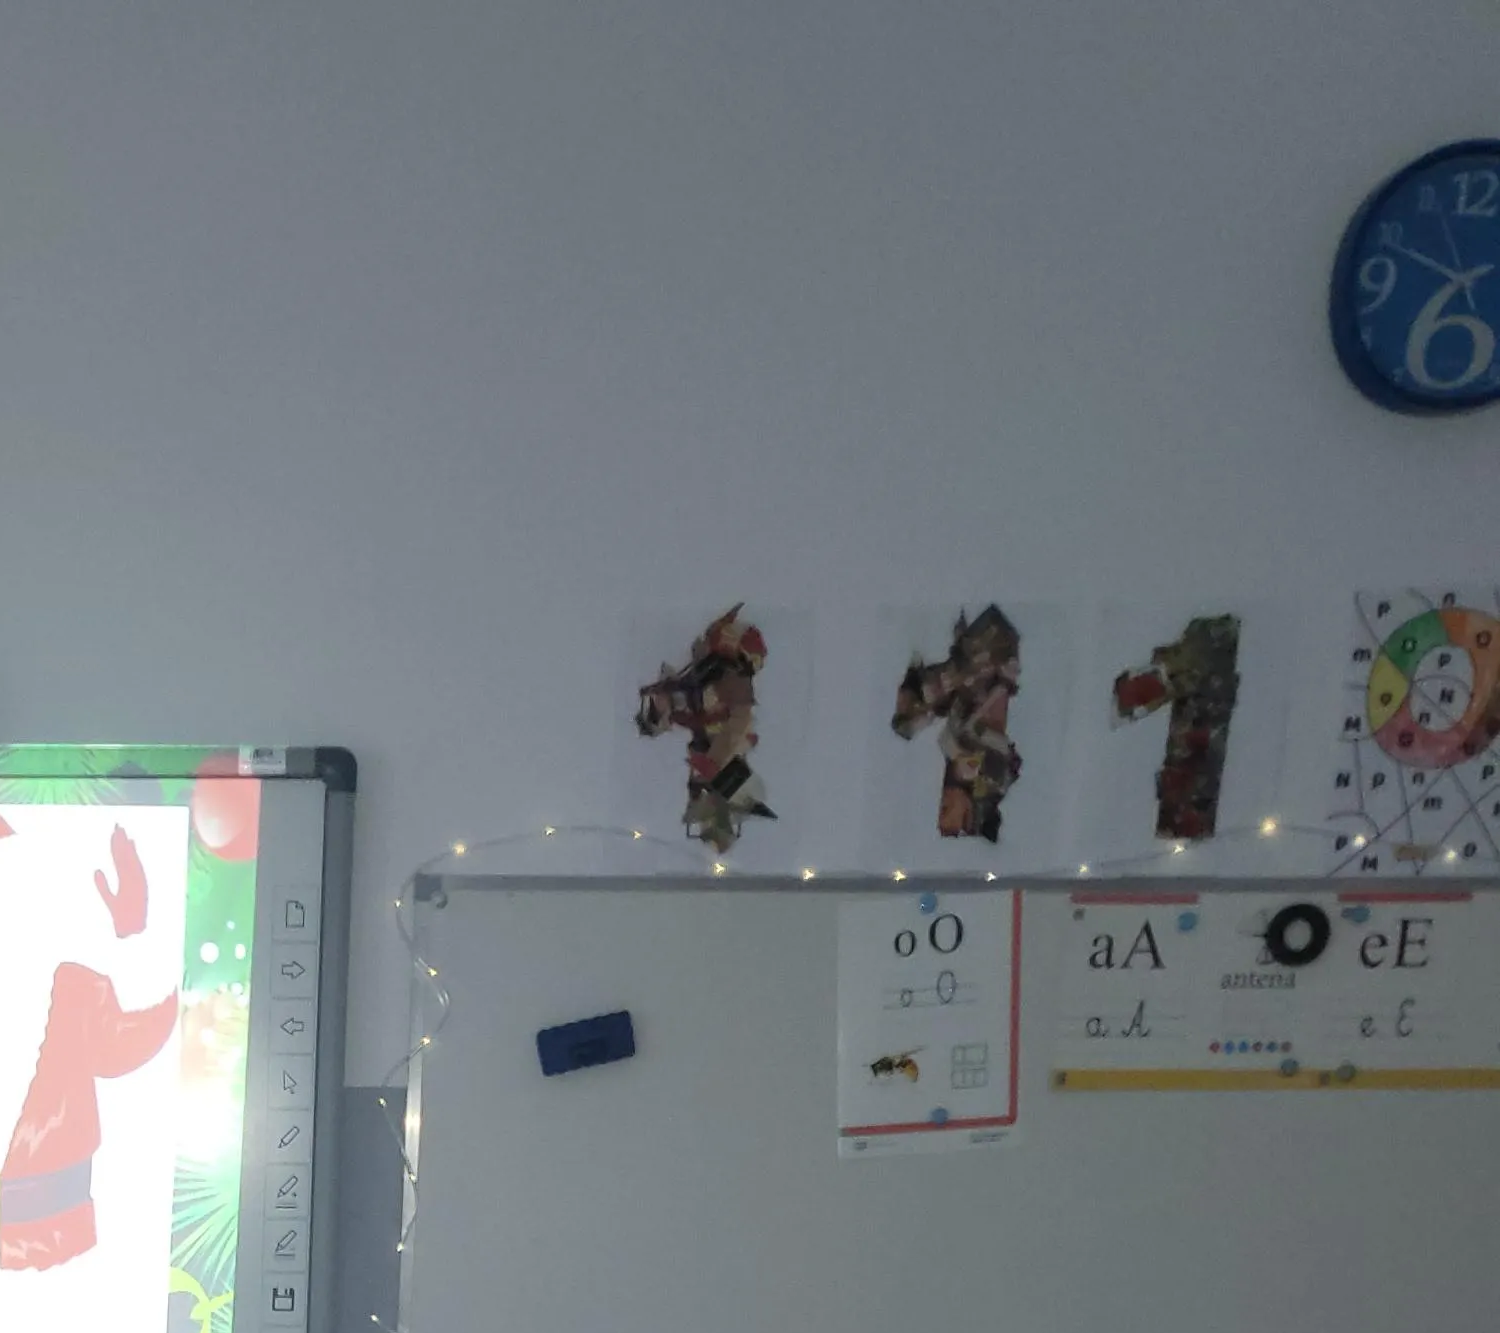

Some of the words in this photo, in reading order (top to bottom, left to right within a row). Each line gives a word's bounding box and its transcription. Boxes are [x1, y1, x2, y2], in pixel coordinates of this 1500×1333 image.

[1452, 169, 1499, 217] 12
[1359, 256, 1398, 316] 9
[1406, 278, 1495, 390] 6
[1219, 970, 1296, 990] antena
